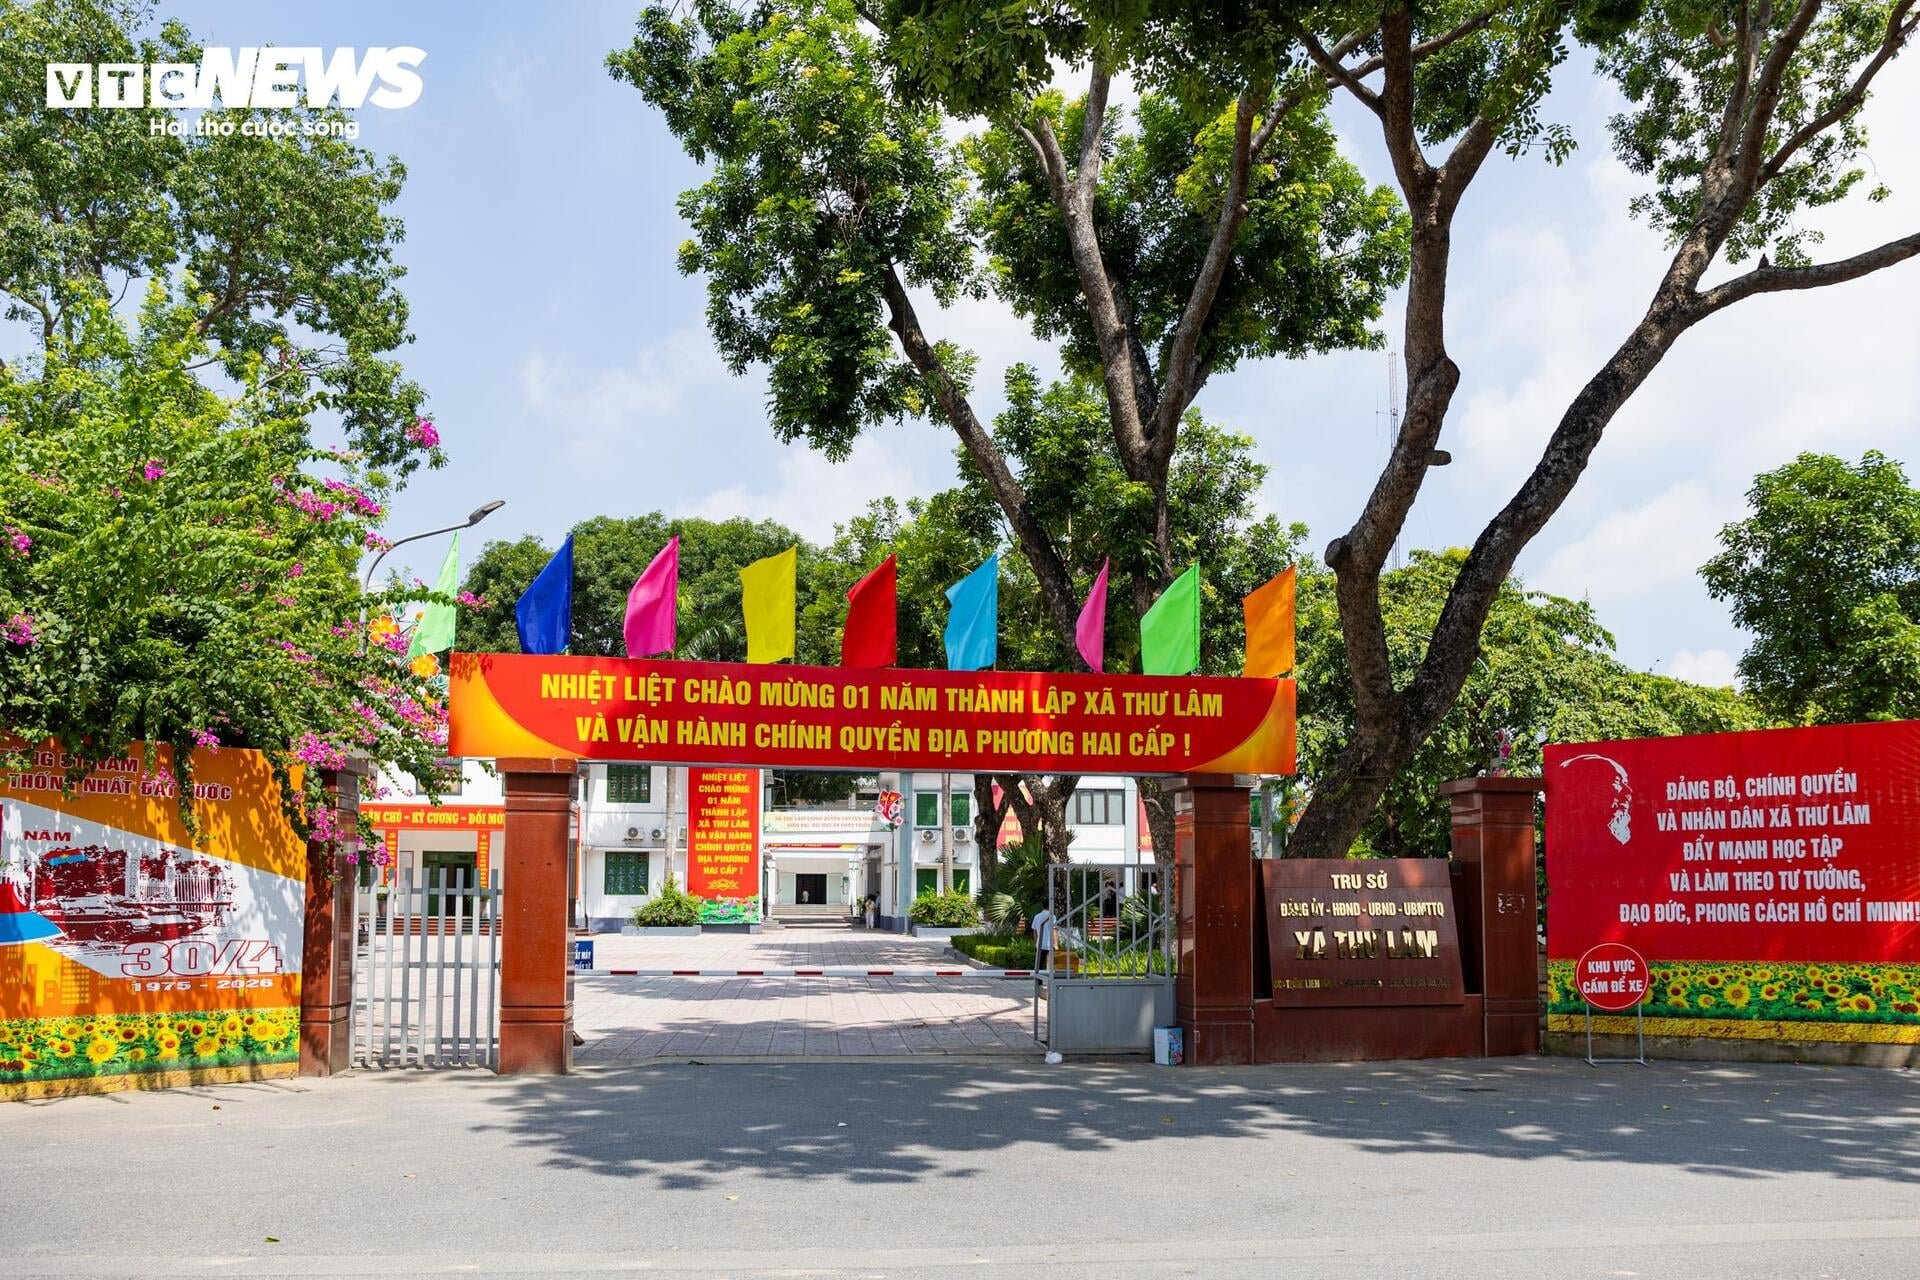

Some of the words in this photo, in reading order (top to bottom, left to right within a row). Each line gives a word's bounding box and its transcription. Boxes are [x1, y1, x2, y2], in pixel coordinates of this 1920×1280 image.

[541, 670, 616, 705] NHIỆT
[625, 672, 676, 707] LIỆT
[685, 675, 751, 705] CHÀO
[760, 676, 835, 709] MỪNG
[843, 685, 870, 709] 01
[880, 682, 937, 711] NĂM
[945, 684, 1024, 714] THÀNH
[1032, 686, 1077, 719] LẬP
[1084, 687, 1116, 715] XÃ
[1123, 691, 1169, 717] THƯ
[1174, 688, 1223, 717] LÂM
[576, 713, 609, 742] VÀ
[617, 713, 668, 749] VẬN
[677, 715, 746, 746] HÀNH
[755, 716, 831, 749] CHÍNH
[840, 720, 920, 752] QUYỀN
[928, 728, 969, 758] ĐỊA
[977, 728, 1074, 755] PHƯƠNG
[1083, 731, 1121, 756] HAI
[1130, 725, 1175, 756] CẤP
[83, 776, 133, 795] NHẤT
[193, 783, 232, 800] ƯỚC
[1666, 775, 1709, 801] ĐẢNG
[1714, 776, 1741, 803] BỘ,
[1745, 773, 1796, 797] CHÍNH
[1801, 767, 1857, 795] QUYỀN
[1656, 809, 1677, 832] VÀ
[1682, 806, 1726, 830] NHÂN
[1730, 804, 1764, 829] DÂN
[1769, 804, 1792, 828] XÃ
[1797, 804, 1830, 826] THƯ
[1833, 801, 1870, 825] LÂM
[24, 830, 71, 841] NĂM
[1683, 834, 1714, 861] ĐẨY
[1719, 839, 1766, 864] MẠNH
[1773, 838, 1806, 864] HỌC
[1811, 834, 1843, 863] TẬP
[1331, 874, 1362, 893] TRỤ
[1366, 870, 1388, 889] SỞ
[1670, 869, 1690, 892] VÀ
[1695, 868, 1729, 892] LÀM
[1733, 870, 1774, 891] THEO
[1778, 869, 1802, 890] TƯ
[1804, 863, 1866, 893] TƯỞNG,
[1332, 902, 1361, 917] HĐND
[1368, 902, 1396, 917] UBND
[1403, 902, 1445, 917] UBMTTQ
[1619, 903, 1650, 927] ĐẠO
[1654, 899, 1691, 925] ĐỨC,
[1695, 902, 1750, 923] PHONG
[1755, 898, 1799, 922] CÁCH
[1804, 895, 1827, 922] HỒ
[1832, 898, 1861, 922] CHÍ
[1294, 926, 1328, 960] XÃ
[1334, 929, 1381, 960] THƯ
[1386, 925, 1439, 960] LÂM
[121, 940, 283, 978] 30/4
[1588, 960, 1610, 974] KHU
[1613, 959, 1635, 976] VỰC
[131, 980, 190, 992] 1975
[216, 978, 274, 990] 2026
[1583, 978, 1608, 994] CẤM
[1610, 976, 1627, 993] ĐỂ
[1628, 979, 1643, 993] XE
